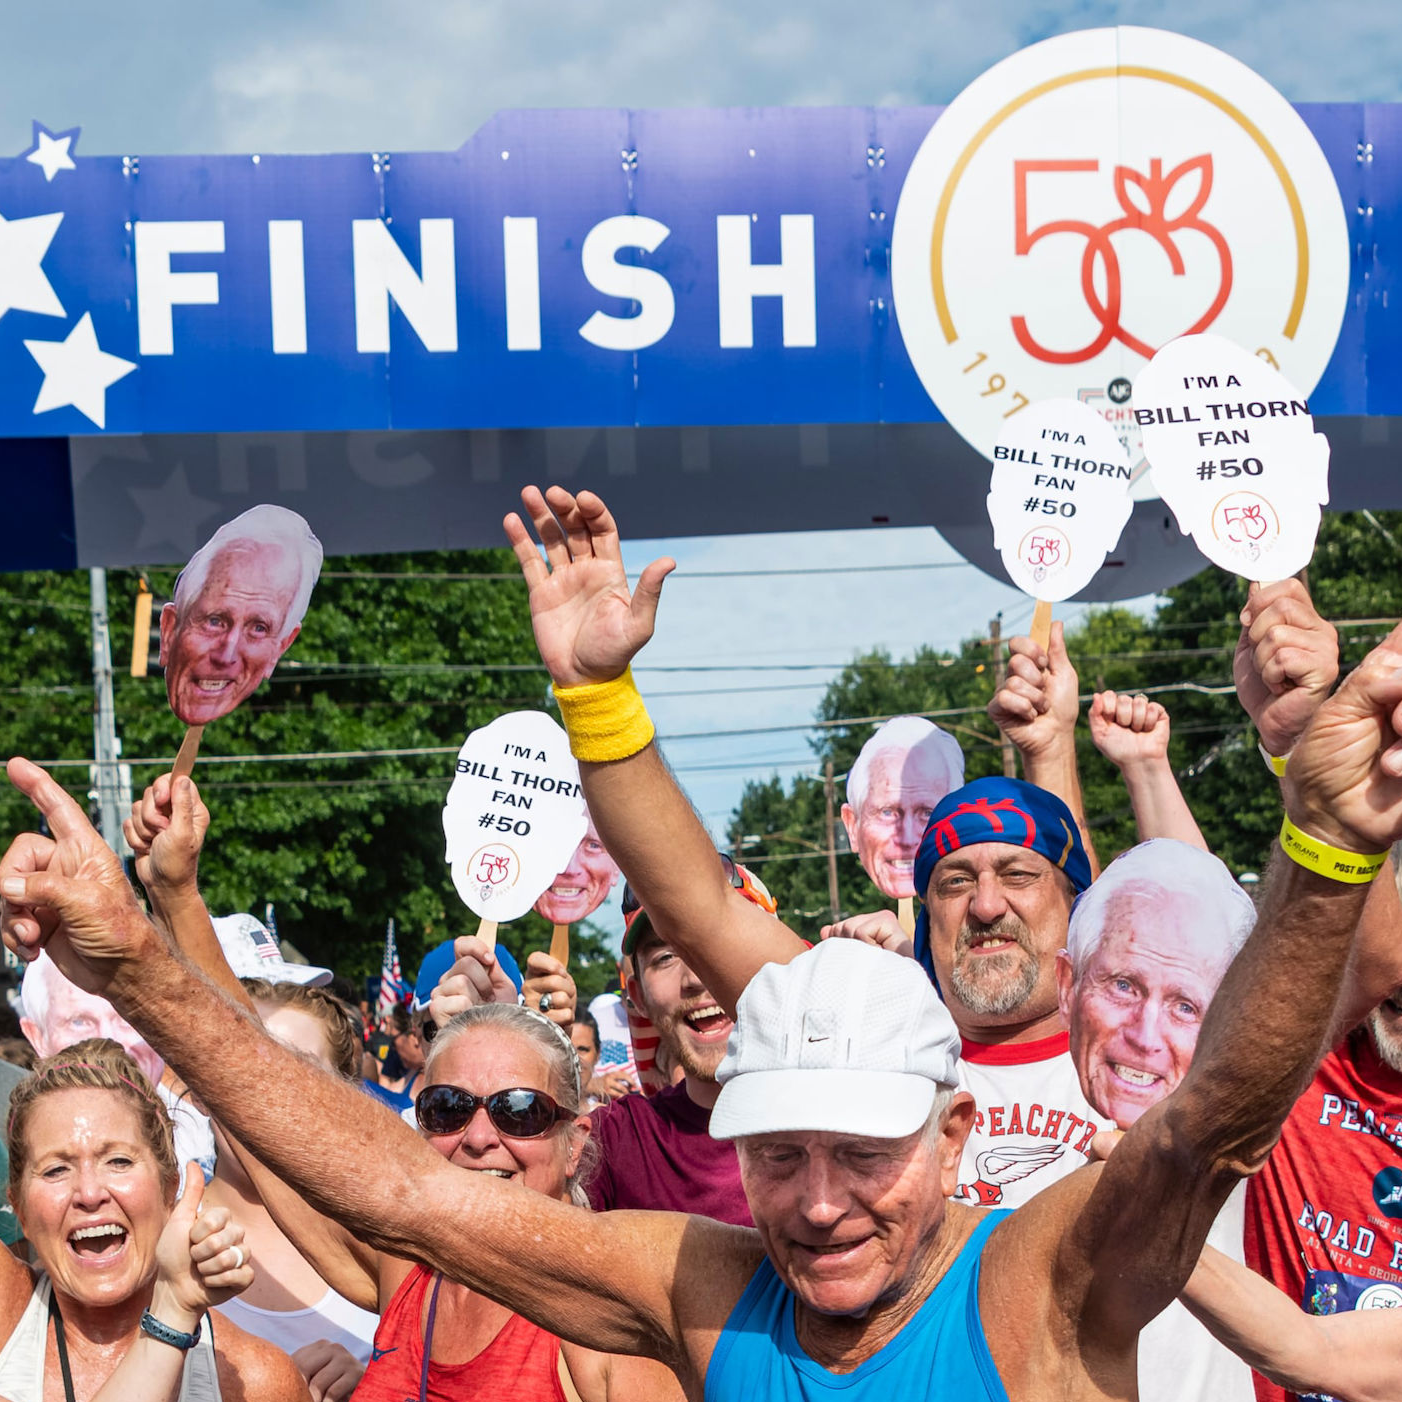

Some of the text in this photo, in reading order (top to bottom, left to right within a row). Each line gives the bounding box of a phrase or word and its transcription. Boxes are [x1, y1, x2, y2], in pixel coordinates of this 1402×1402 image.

[135, 213, 817, 355] FINISH
[963, 352, 1030, 419] 197
[1226, 375, 1241, 387] A
[1134, 406, 1200, 426] BILL
[1206, 399, 1312, 421] THORN
[1074, 433, 1087, 445] A
[1198, 430, 1250, 446] FAN
[994, 445, 1132, 481] BILL THORN
[1197, 458, 1264, 480] #50
[1034, 474, 1076, 491] FAN
[1023, 497, 1077, 518] #50
[535, 751, 547, 762] A
[456, 759, 503, 782] BILL
[492, 790, 533, 810] FAN
[478, 812, 531, 836] #50
[1334, 861, 1355, 875] POST
